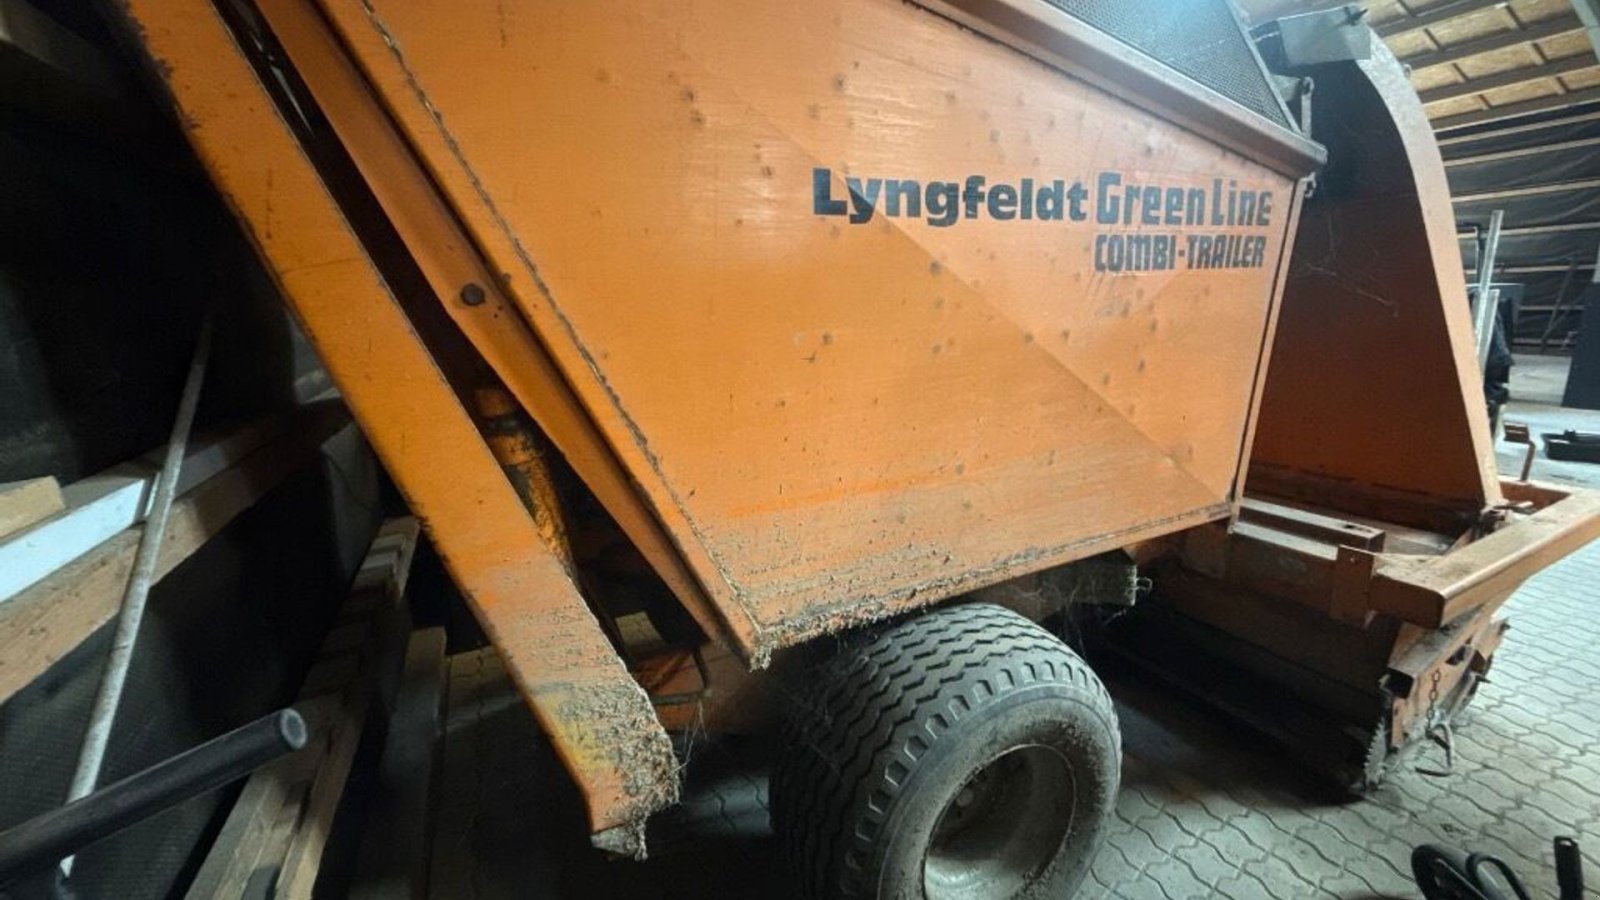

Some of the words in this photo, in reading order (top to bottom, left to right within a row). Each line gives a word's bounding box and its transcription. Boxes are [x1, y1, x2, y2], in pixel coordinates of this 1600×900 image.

[812, 167, 1088, 227] Lyngfeldt
[1096, 172, 1206, 225] Green
[1095, 234, 1267, 272] COMBI-TRAILER
